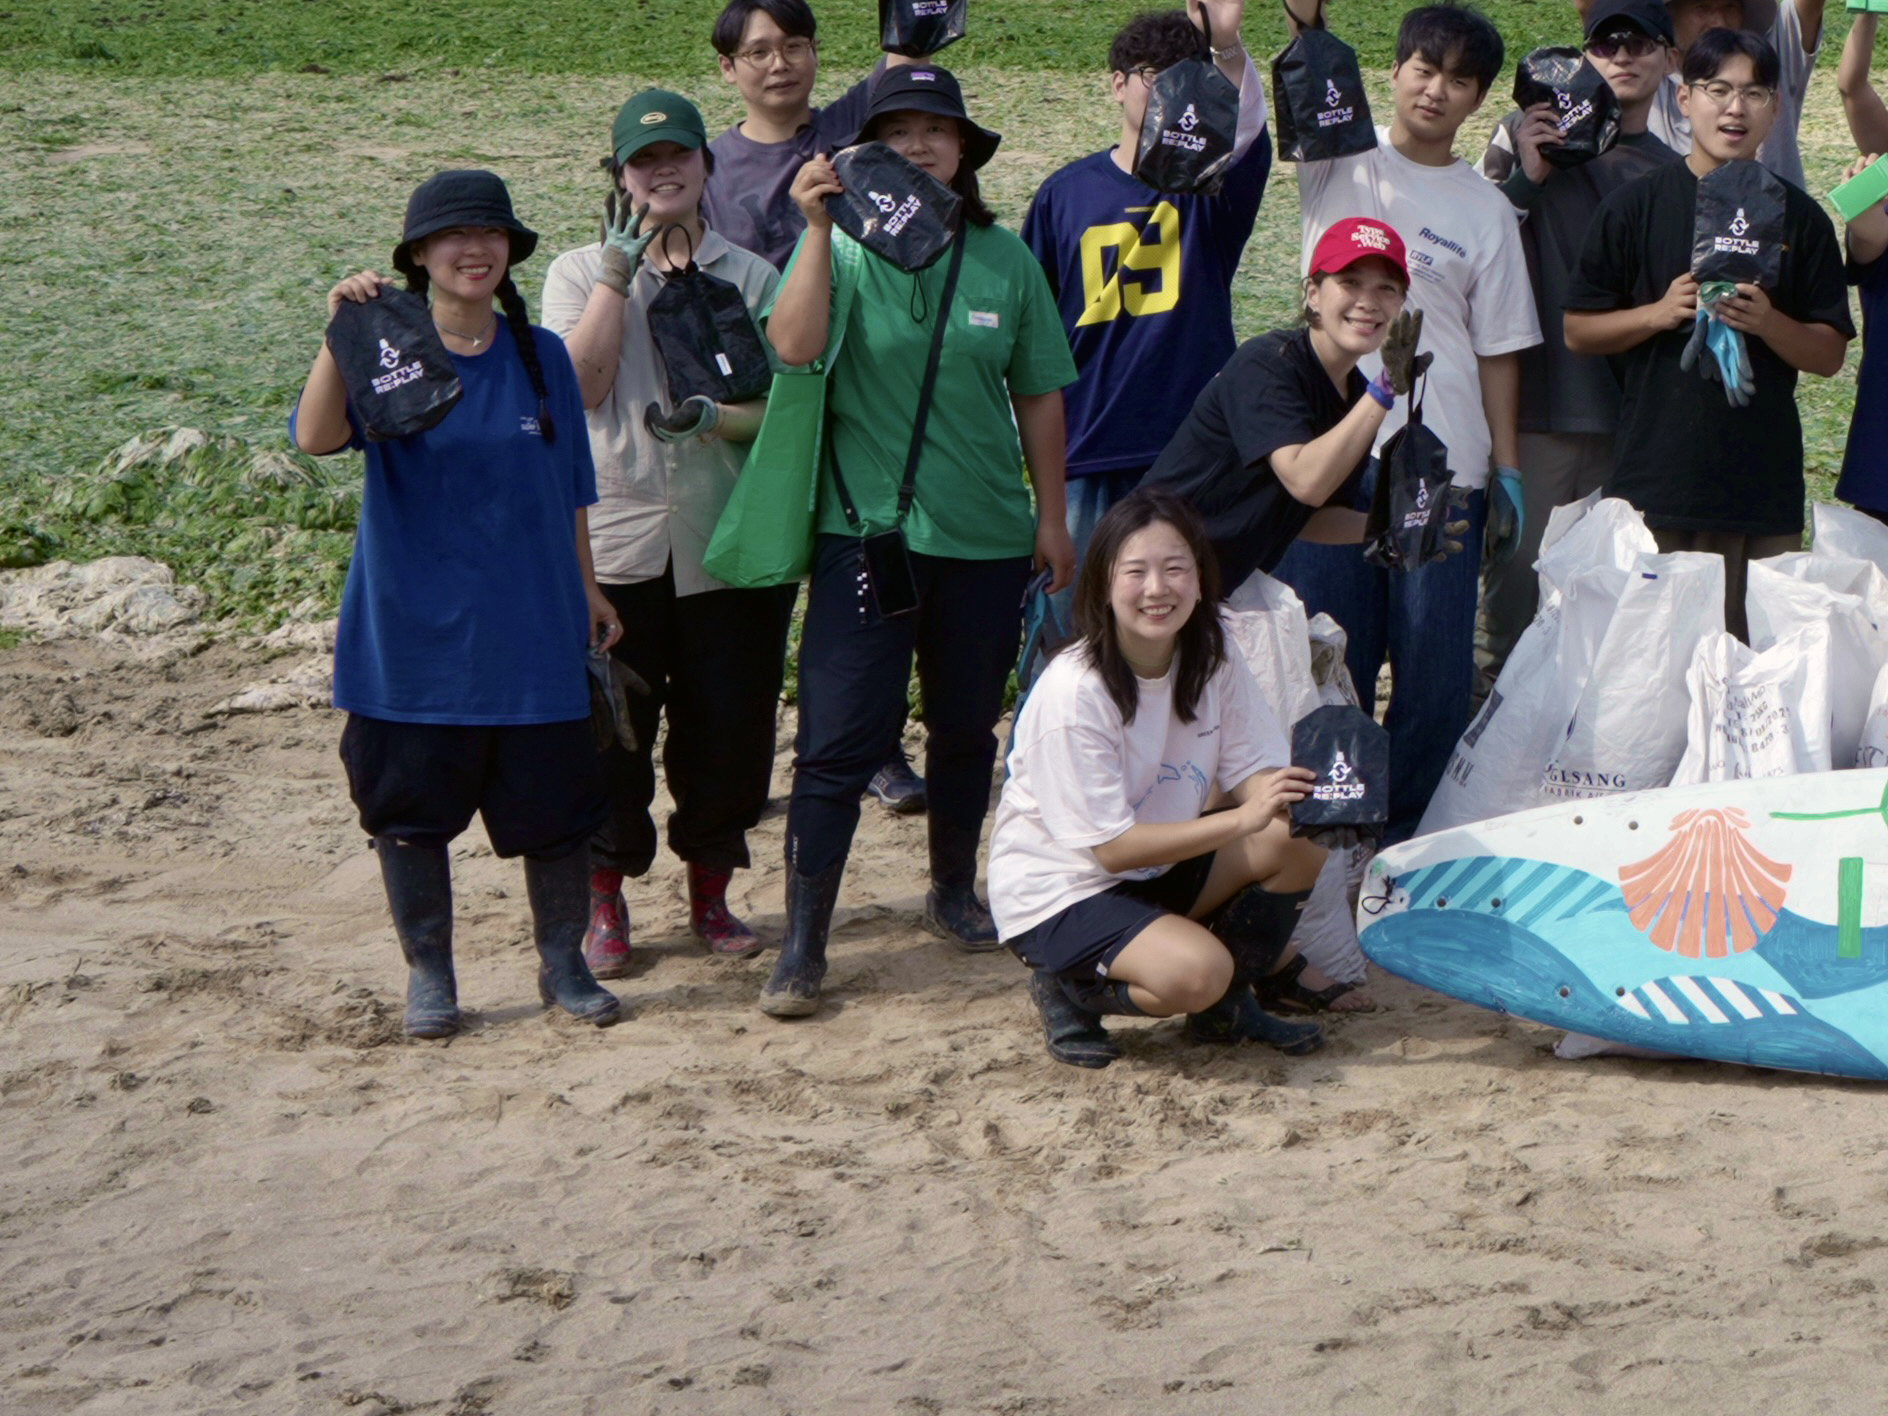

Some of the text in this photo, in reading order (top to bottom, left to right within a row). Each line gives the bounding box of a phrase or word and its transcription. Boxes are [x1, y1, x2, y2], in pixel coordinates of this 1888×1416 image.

[912, 0, 947, 9] BOTTLE
[1317, 106, 1353, 120] BOTTLE
[1163, 130, 1207, 145] BOTTLE
[883, 194, 917, 232] BOTTLE
[1418, 227, 1466, 259] Royallife
[1715, 236, 1760, 248] BOTTLE
[371, 361, 422, 386] BOTTLE
[1405, 509, 1431, 520] BOTTL
[1313, 784, 1365, 793] BOTTLE
